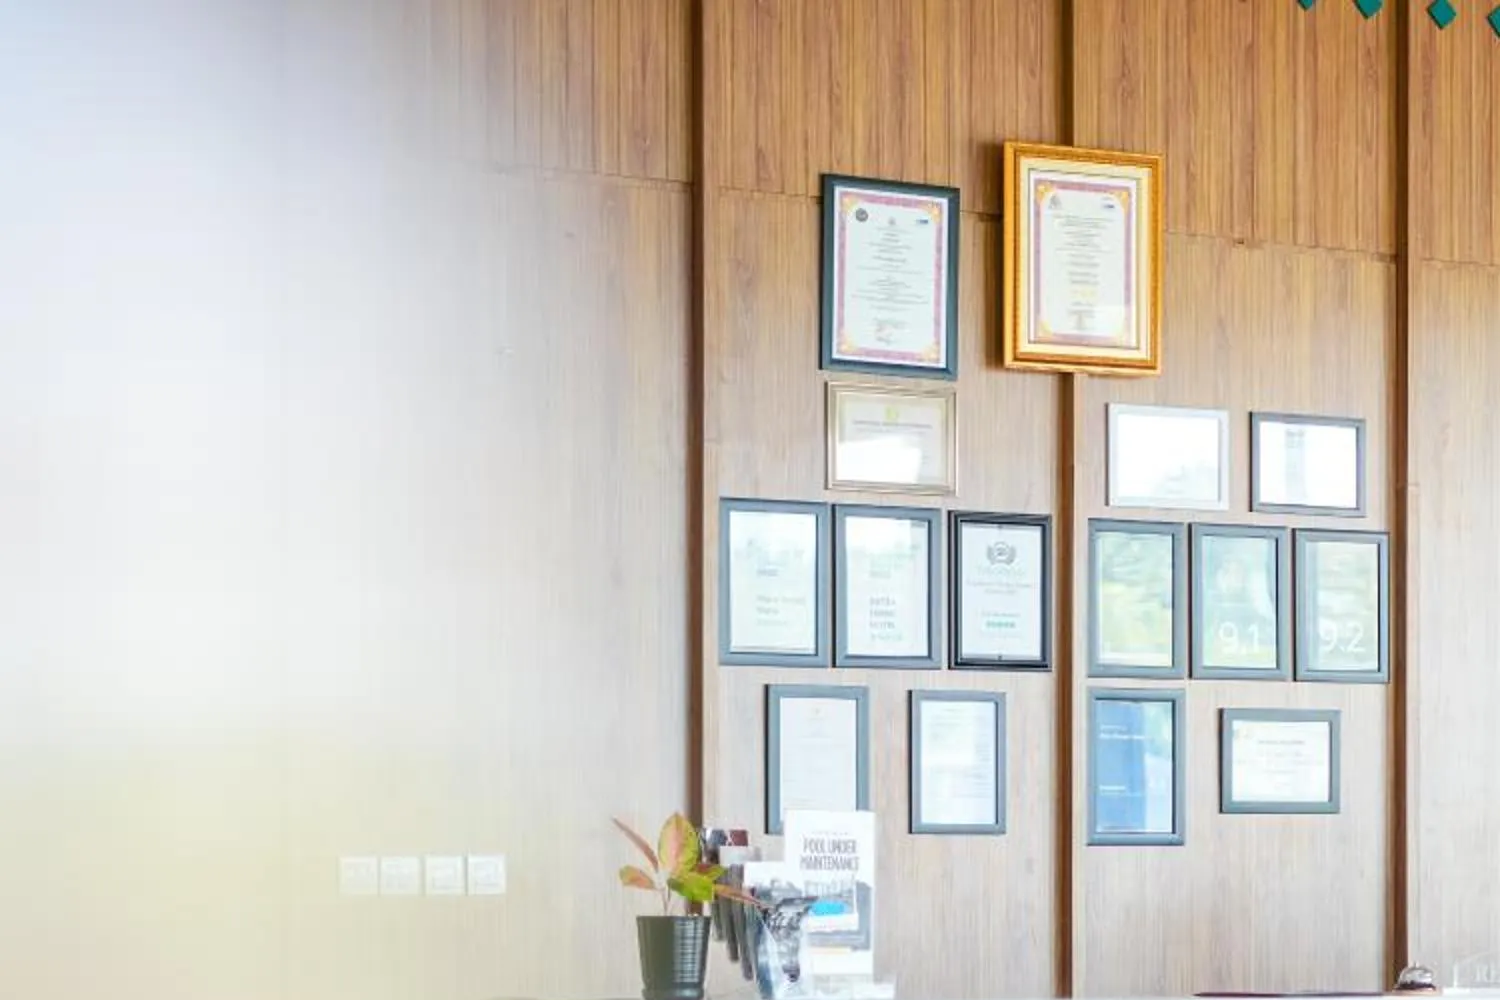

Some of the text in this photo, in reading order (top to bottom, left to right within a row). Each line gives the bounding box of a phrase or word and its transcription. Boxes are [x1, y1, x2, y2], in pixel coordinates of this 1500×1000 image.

[803, 837, 857, 854] POOL UNDER
[800, 855, 860, 871] MAINTENANCE
